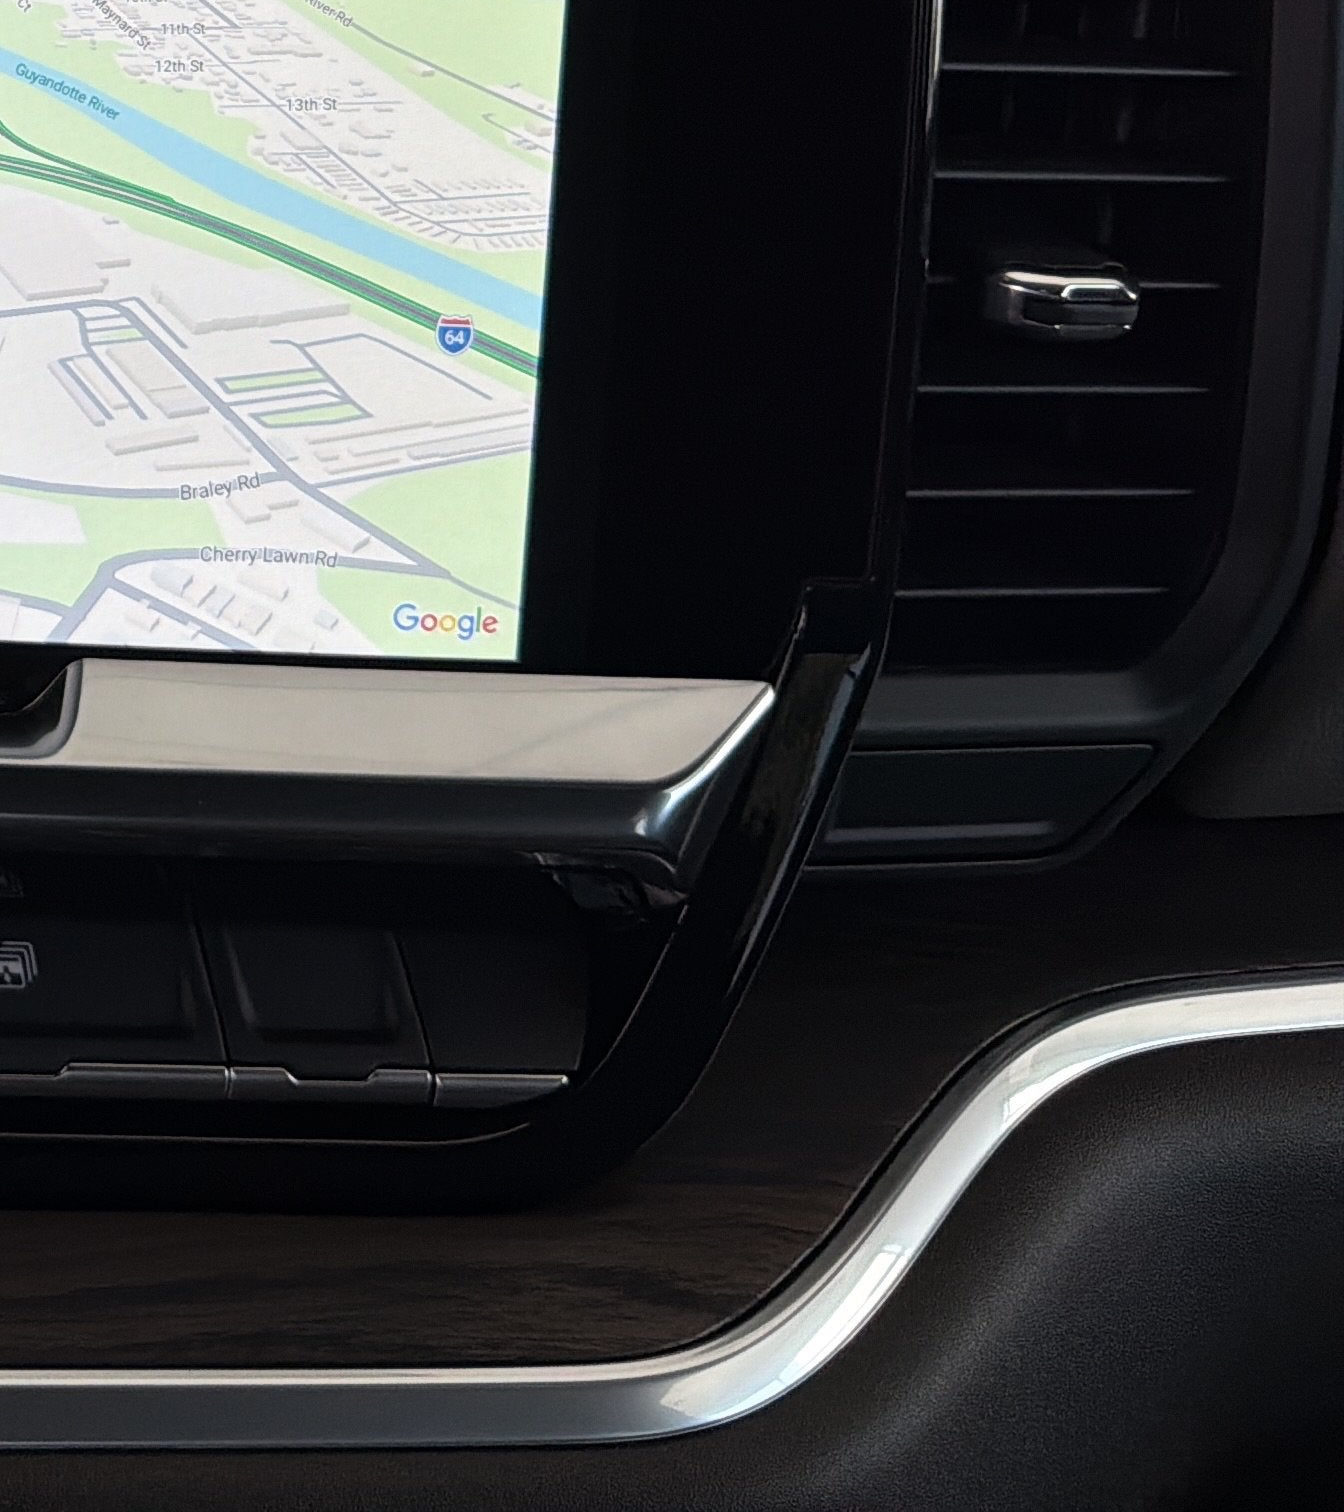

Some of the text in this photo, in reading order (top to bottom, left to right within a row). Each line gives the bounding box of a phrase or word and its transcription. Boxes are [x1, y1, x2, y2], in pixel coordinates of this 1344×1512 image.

[333, 9, 353, 28] Rd
[161, 23, 206, 35] 11th St
[136, 35, 152, 50] St
[155, 60, 204, 73] 12th St
[14, 62, 120, 122] Guyandotte River
[286, 97, 338, 112] 13th St
[443, 329, 465, 346] 64
[179, 471, 262, 501] Braley Rd
[199, 546, 338, 569] Cherry Lawn Rd
[392, 602, 499, 641] Google
